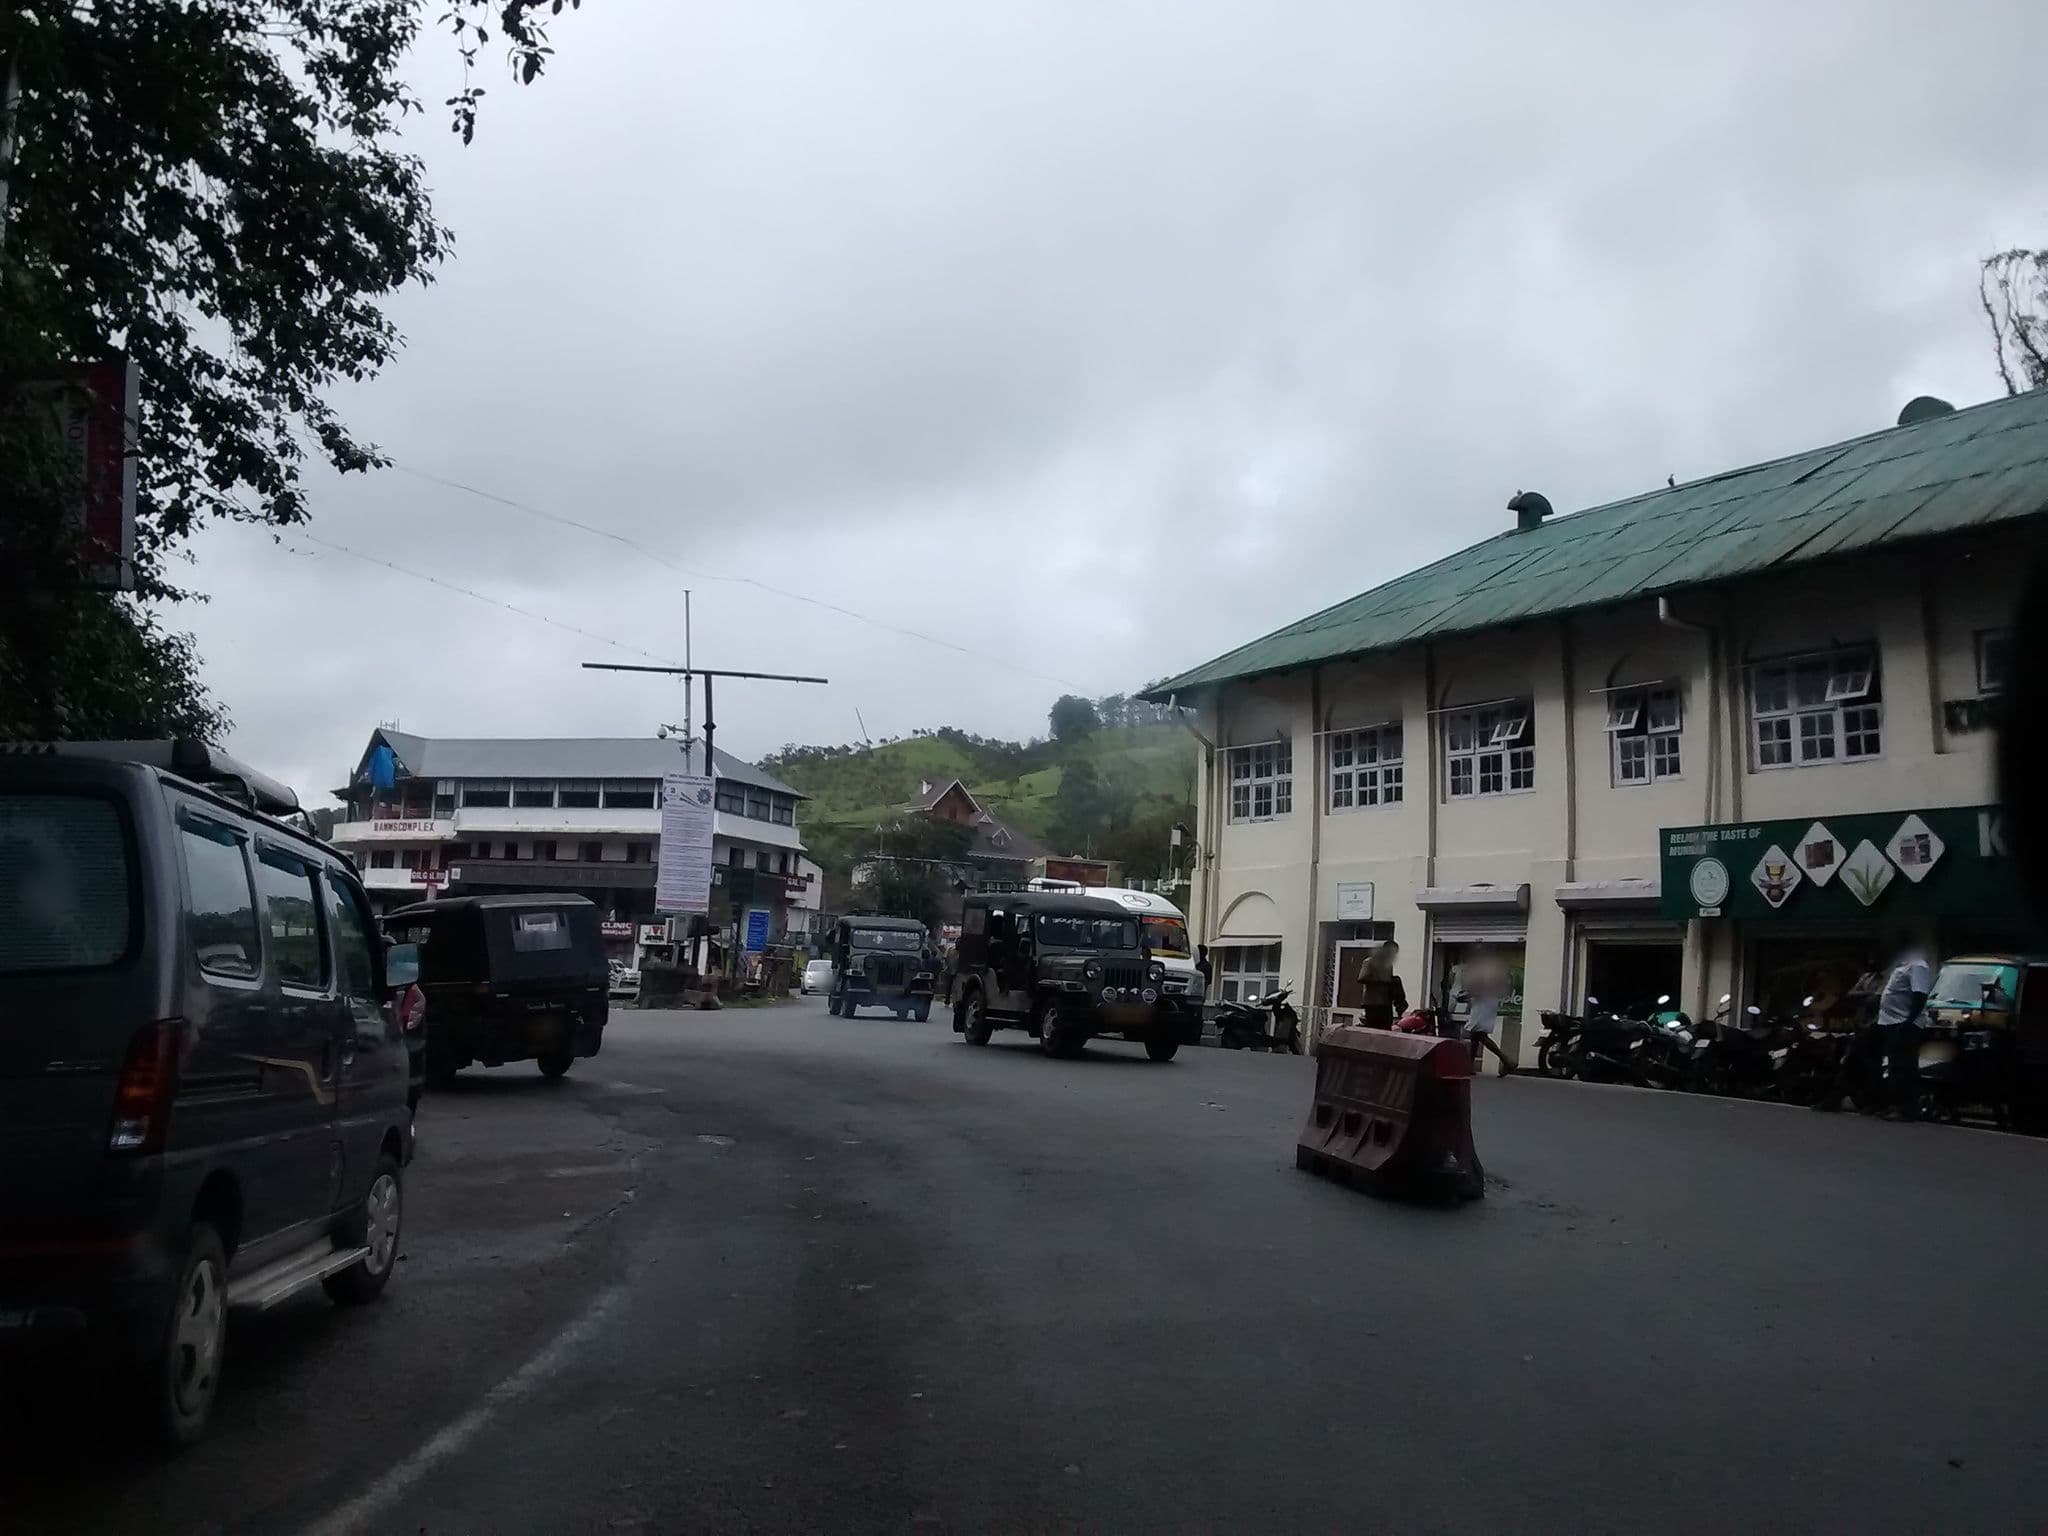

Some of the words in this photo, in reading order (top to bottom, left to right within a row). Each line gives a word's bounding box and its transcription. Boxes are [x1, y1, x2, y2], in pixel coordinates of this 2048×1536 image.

[1720, 829, 1747, 840] TASTE
[1749, 828, 1761, 838] OF
[1669, 846, 1706, 856] MUN
